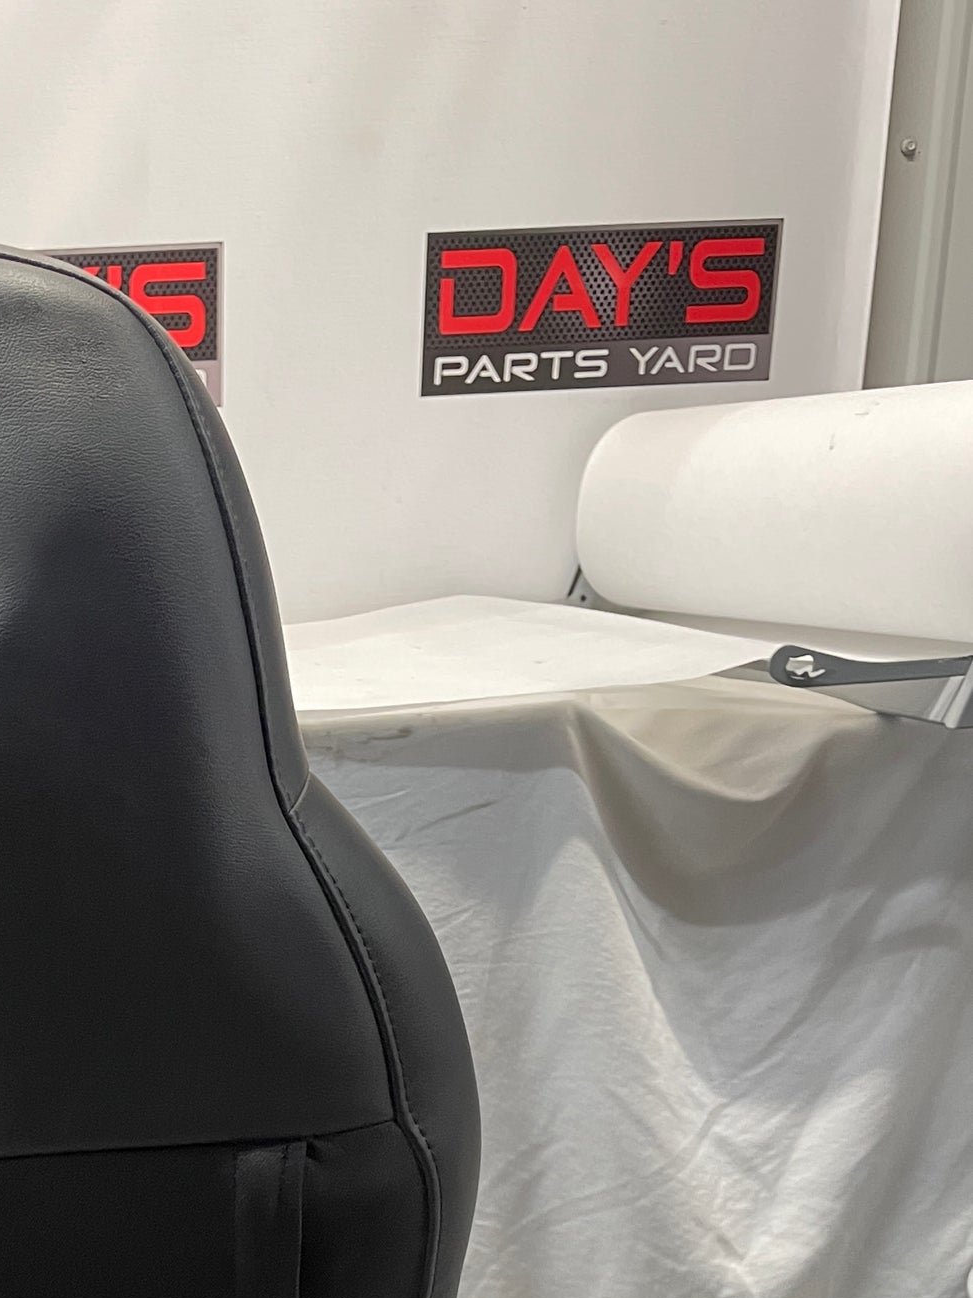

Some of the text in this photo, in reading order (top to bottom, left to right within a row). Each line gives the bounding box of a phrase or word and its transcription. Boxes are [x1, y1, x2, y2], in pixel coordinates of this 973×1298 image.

[438, 238, 766, 335] DAY'S
[433, 342, 757, 386] PARTS YARD
